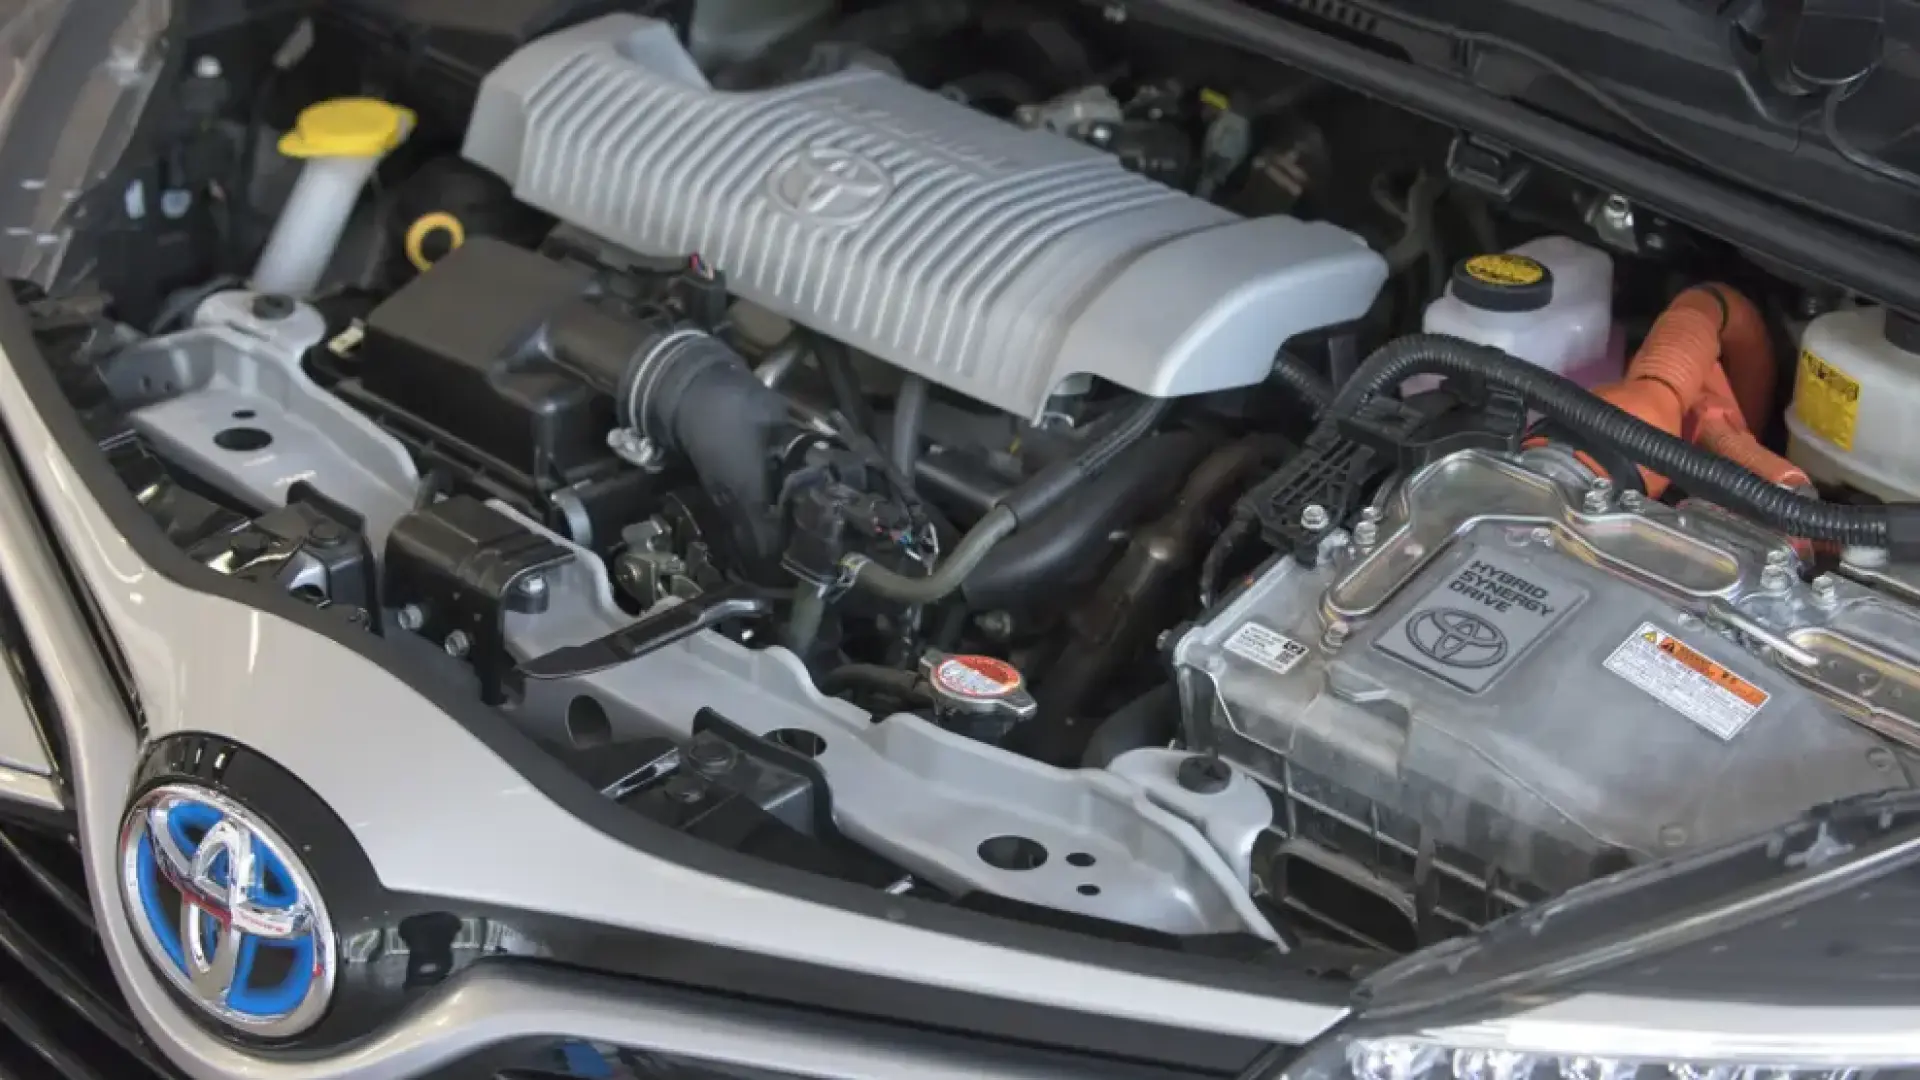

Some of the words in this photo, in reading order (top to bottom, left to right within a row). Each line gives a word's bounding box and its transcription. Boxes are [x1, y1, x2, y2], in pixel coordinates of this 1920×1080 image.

[1449, 580, 1511, 613] DRIVE
[1459, 570, 1554, 616] SYNERGY
[1470, 560, 1549, 599] HYBRID
